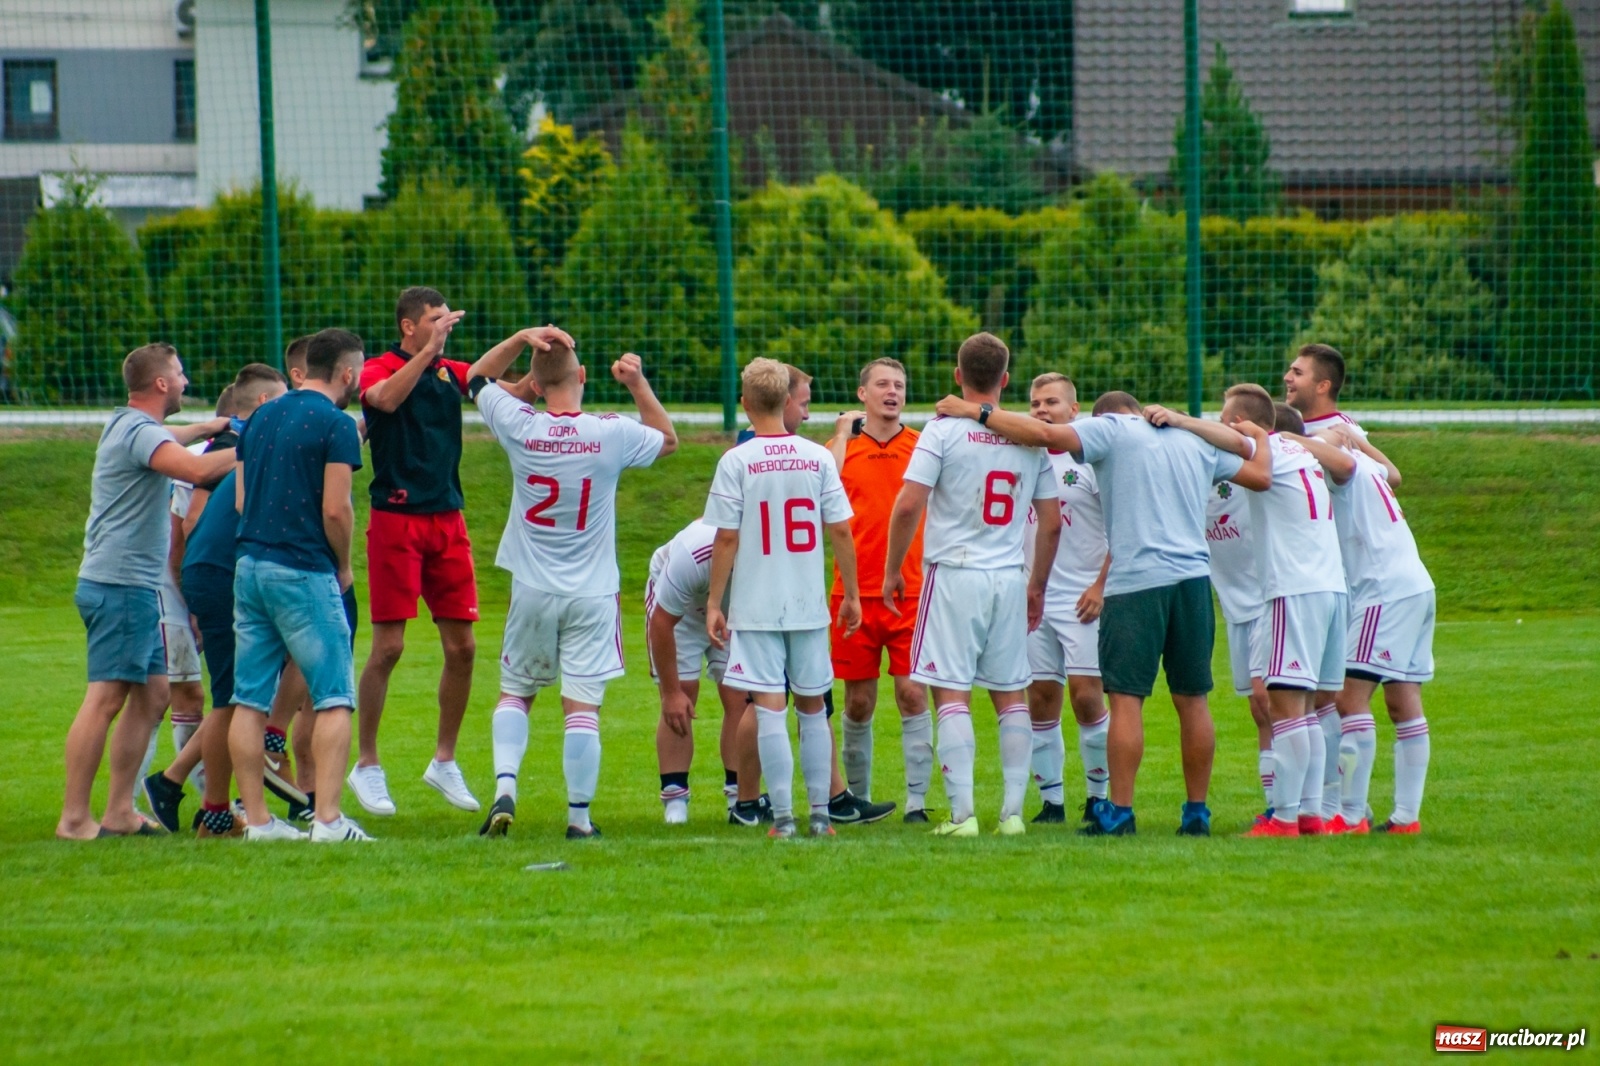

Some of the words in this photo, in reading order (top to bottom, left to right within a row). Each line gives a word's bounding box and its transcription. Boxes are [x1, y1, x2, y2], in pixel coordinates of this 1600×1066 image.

[524, 439, 601, 454] NIEBOCZOWY
[967, 431, 1020, 446] NIEBOCZ
[748, 459, 819, 475] NIEBOCZOWY
[525, 474, 592, 531] 21
[983, 470, 1017, 526] 6
[760, 498, 816, 555] 16
